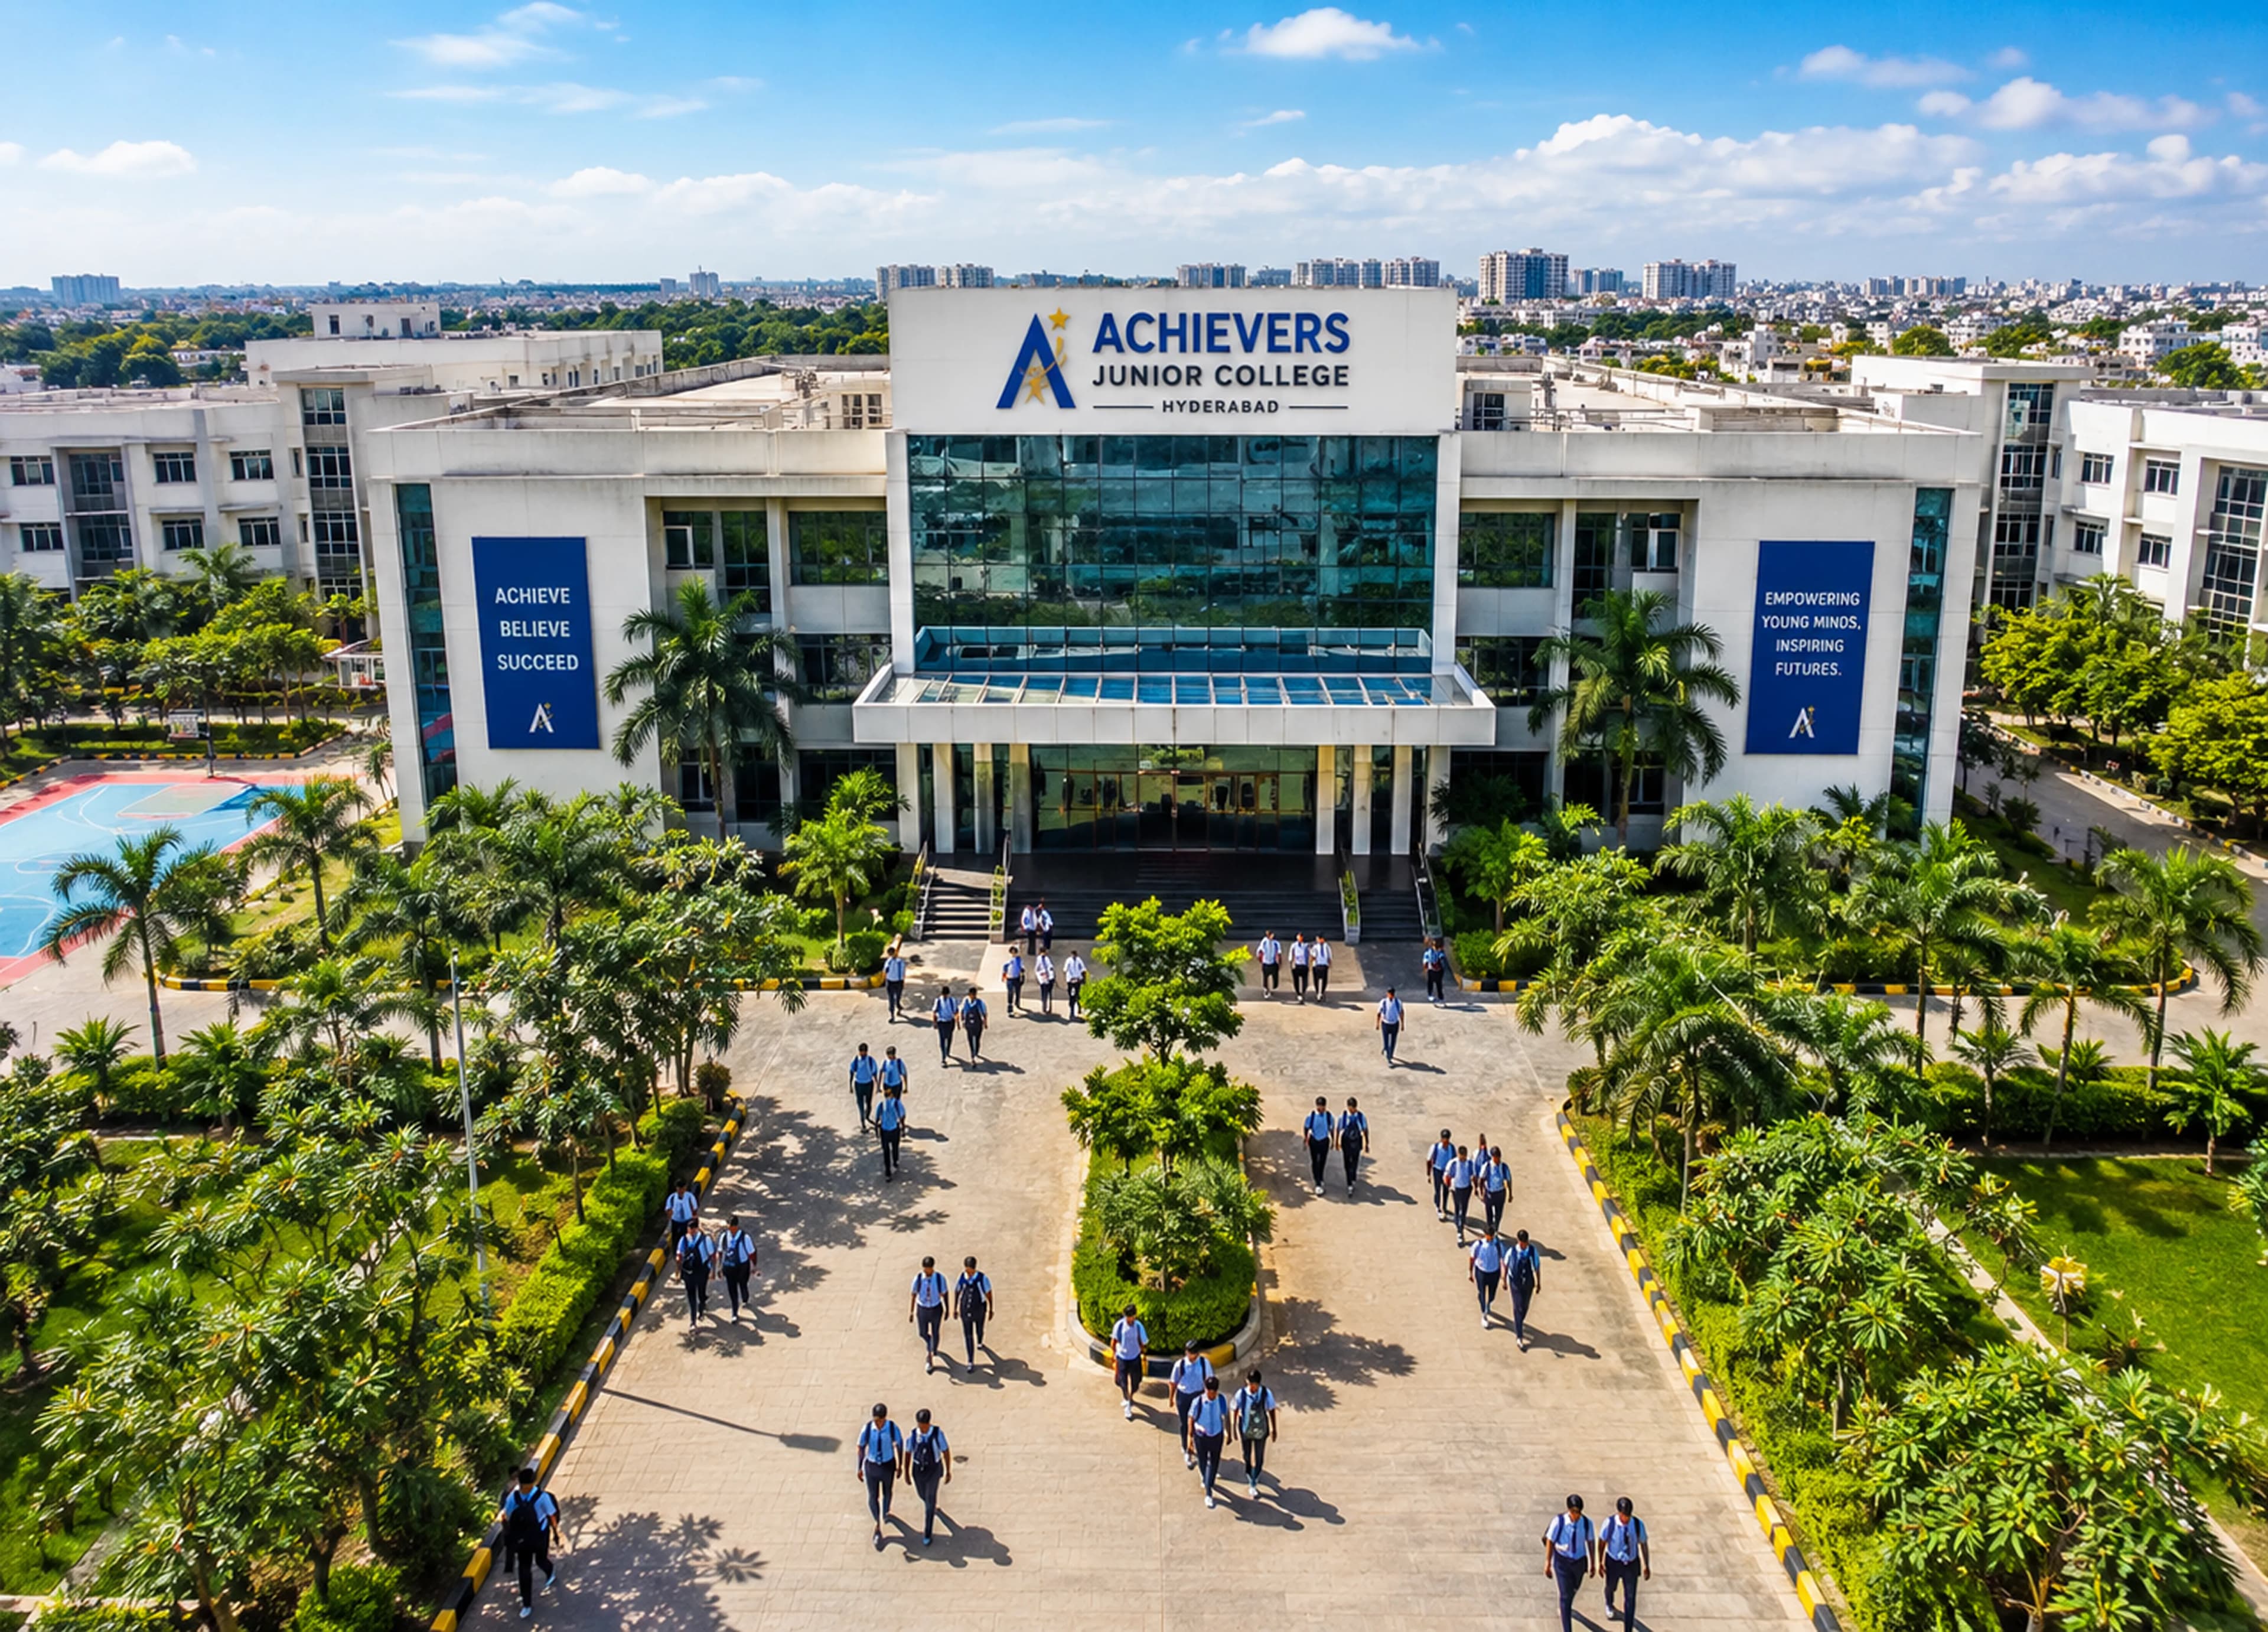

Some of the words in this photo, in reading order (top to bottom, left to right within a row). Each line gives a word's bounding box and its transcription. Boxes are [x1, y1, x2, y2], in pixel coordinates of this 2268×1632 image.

[1092, 312, 1350, 354] ACHIEVERS
[1092, 364, 1203, 387] JUNIOR
[1214, 364, 1349, 387] COLLEGE
[1162, 400, 1279, 413] HYDERABAD
[495, 587, 571, 604] ACHIEVE
[1765, 592, 1860, 606] EMPOWERING
[500, 620, 571, 637] BELIEVE
[1762, 615, 1810, 629] YOUNG
[1775, 639, 1844, 653] INSPIRING
[497, 654, 579, 670] SUCCEED
[1775, 662, 1842, 676] FUTURES.
